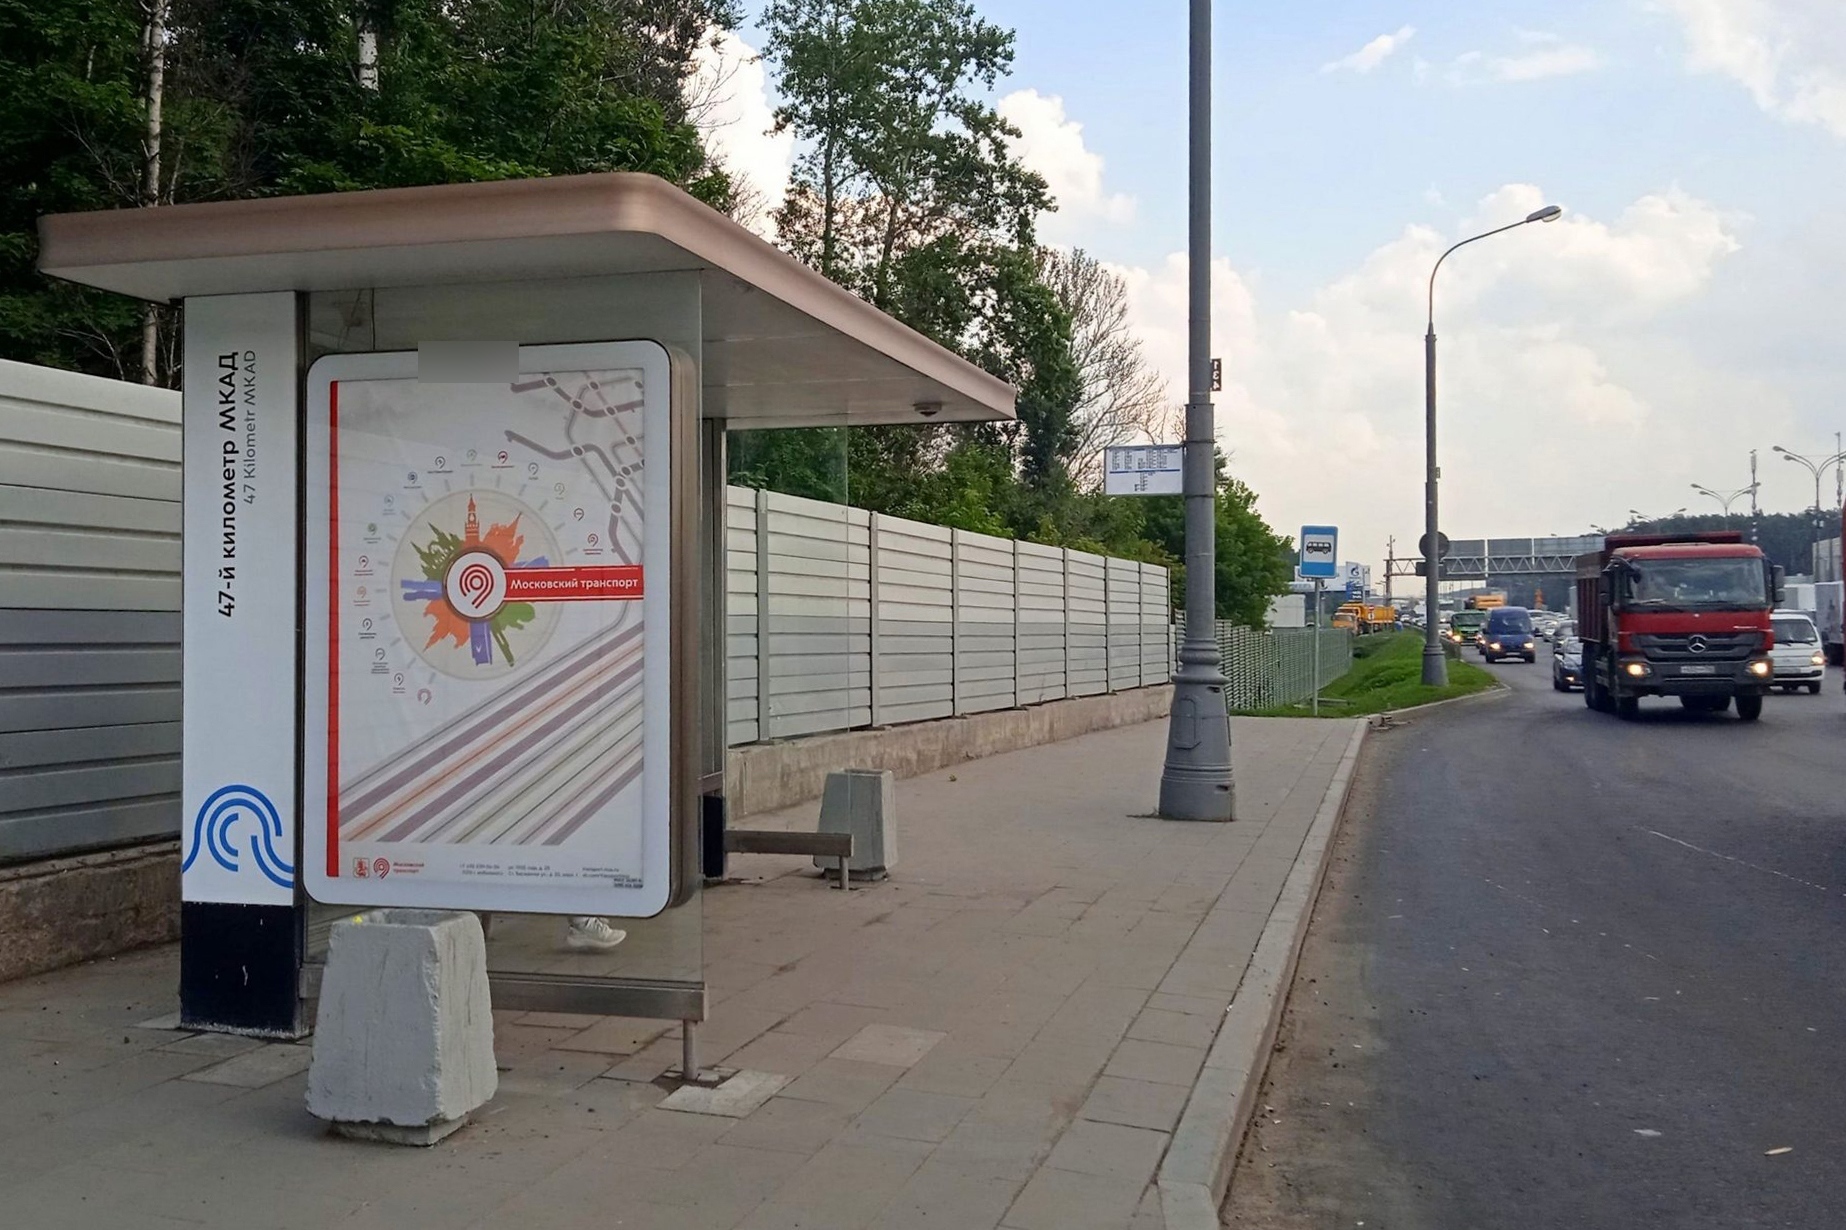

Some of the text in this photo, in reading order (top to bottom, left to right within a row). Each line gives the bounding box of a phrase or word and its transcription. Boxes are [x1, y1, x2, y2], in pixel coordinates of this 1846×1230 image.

[218, 352, 240, 617] 47-й километр МКАД
[243, 350, 256, 505] 47 Kilometr MKAD
[510, 578, 639, 590] Московский транспорт
